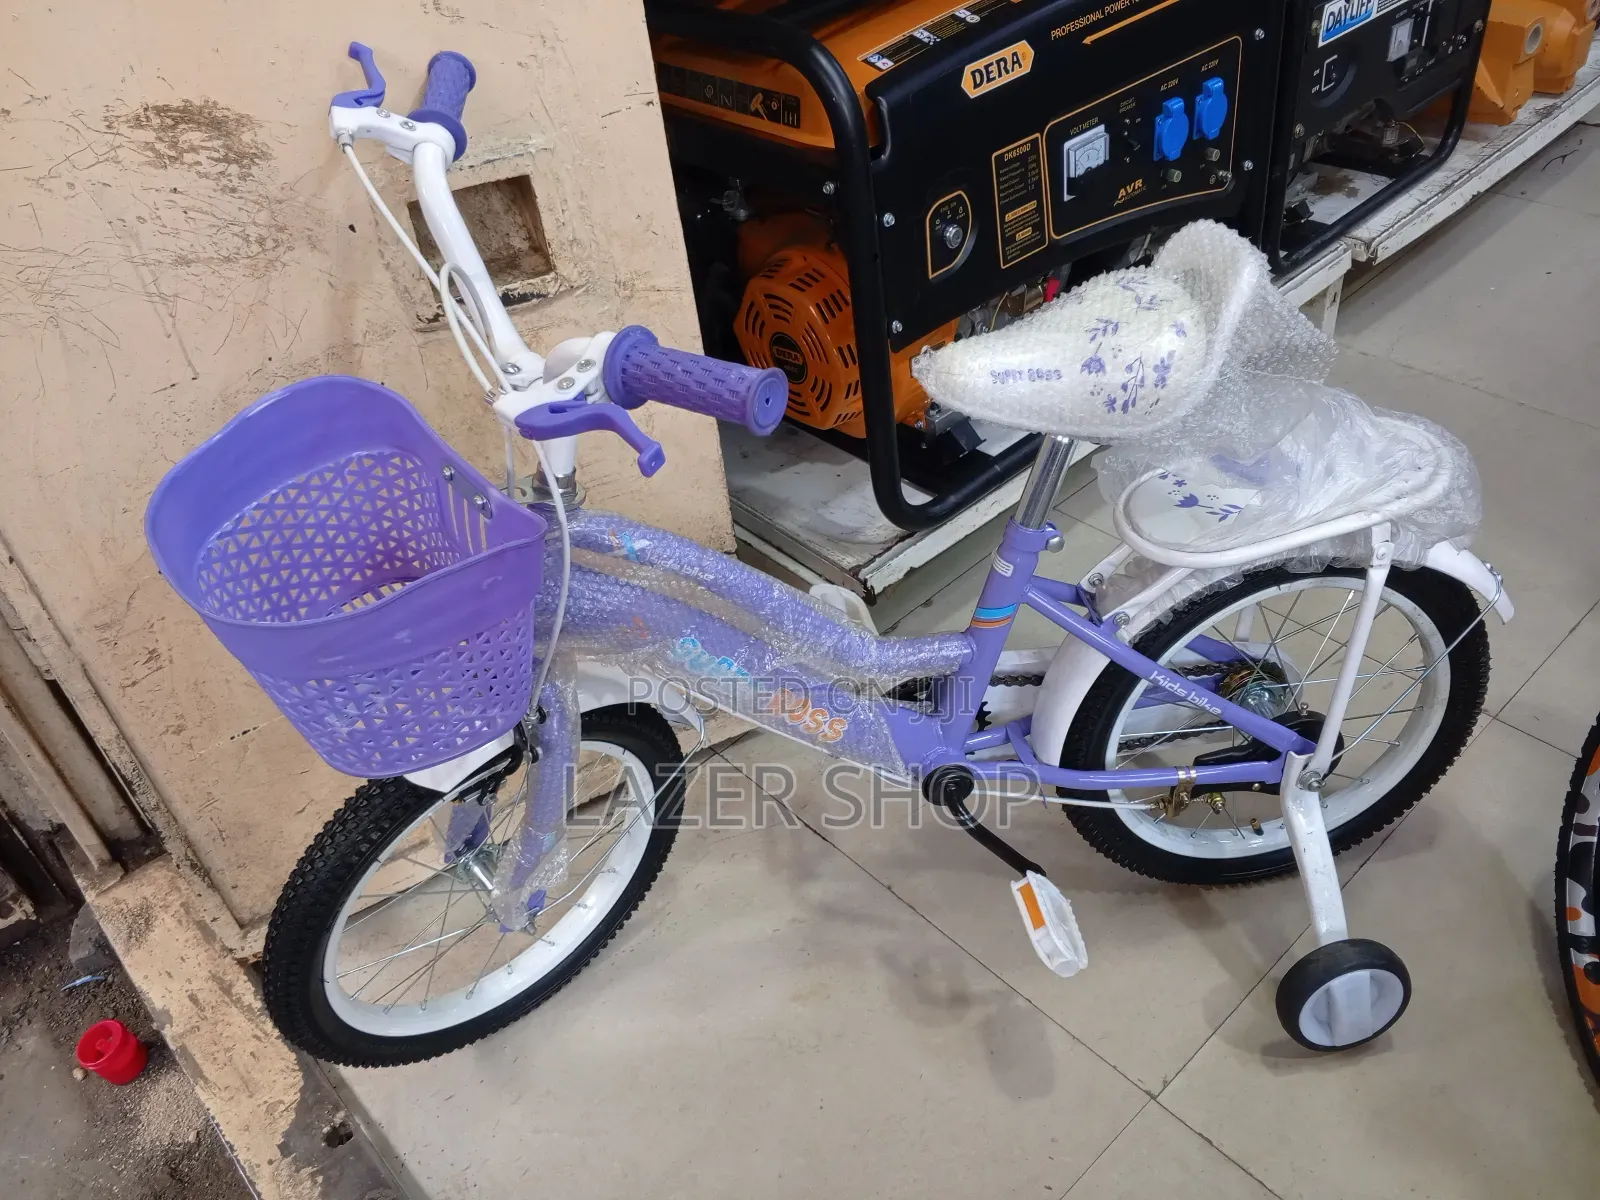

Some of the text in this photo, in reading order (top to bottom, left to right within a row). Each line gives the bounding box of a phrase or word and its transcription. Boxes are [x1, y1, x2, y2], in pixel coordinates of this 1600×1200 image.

[1051, 0, 1130, 40] PROFESSIONAL POWER
[970, 51, 1022, 91] DERA
[1160, 83, 1168, 92] AC
[1004, 144, 1031, 161] DK6500D
[1118, 178, 1144, 199] AVR
[1149, 670, 1222, 715] Kids bike
